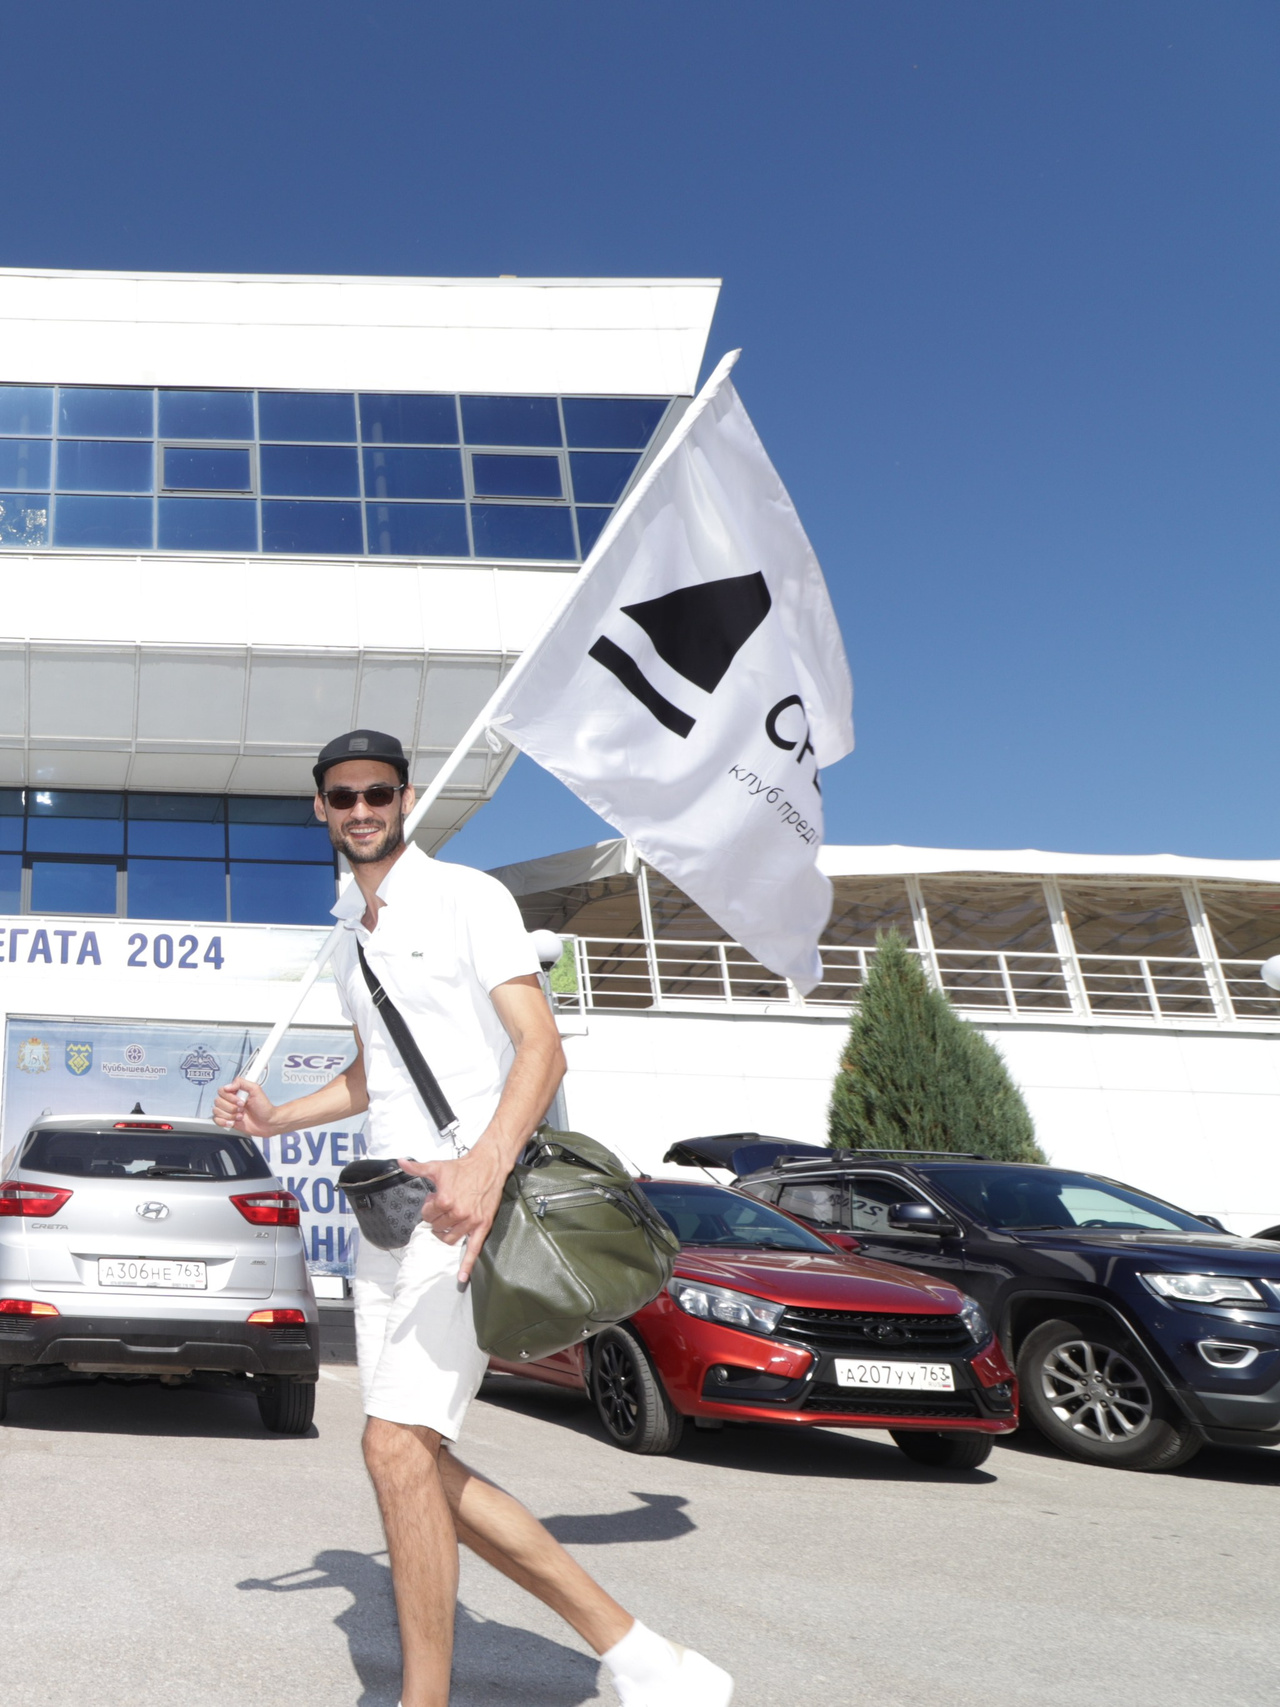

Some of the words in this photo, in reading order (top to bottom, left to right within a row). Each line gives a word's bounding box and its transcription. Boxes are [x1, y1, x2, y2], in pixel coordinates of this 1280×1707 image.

[728, 764, 784, 804] клуб
[127, 932, 225, 970] 2024
[102, 1063, 166, 1074] КуйбышевАзот
[284, 1055, 345, 1069] SCF
[31, 1222, 69, 1230] CRETA
[106, 1262, 172, 1280] А306НЕ
[176, 1264, 201, 1277] 763
[920, 1366, 948, 1381] 763
